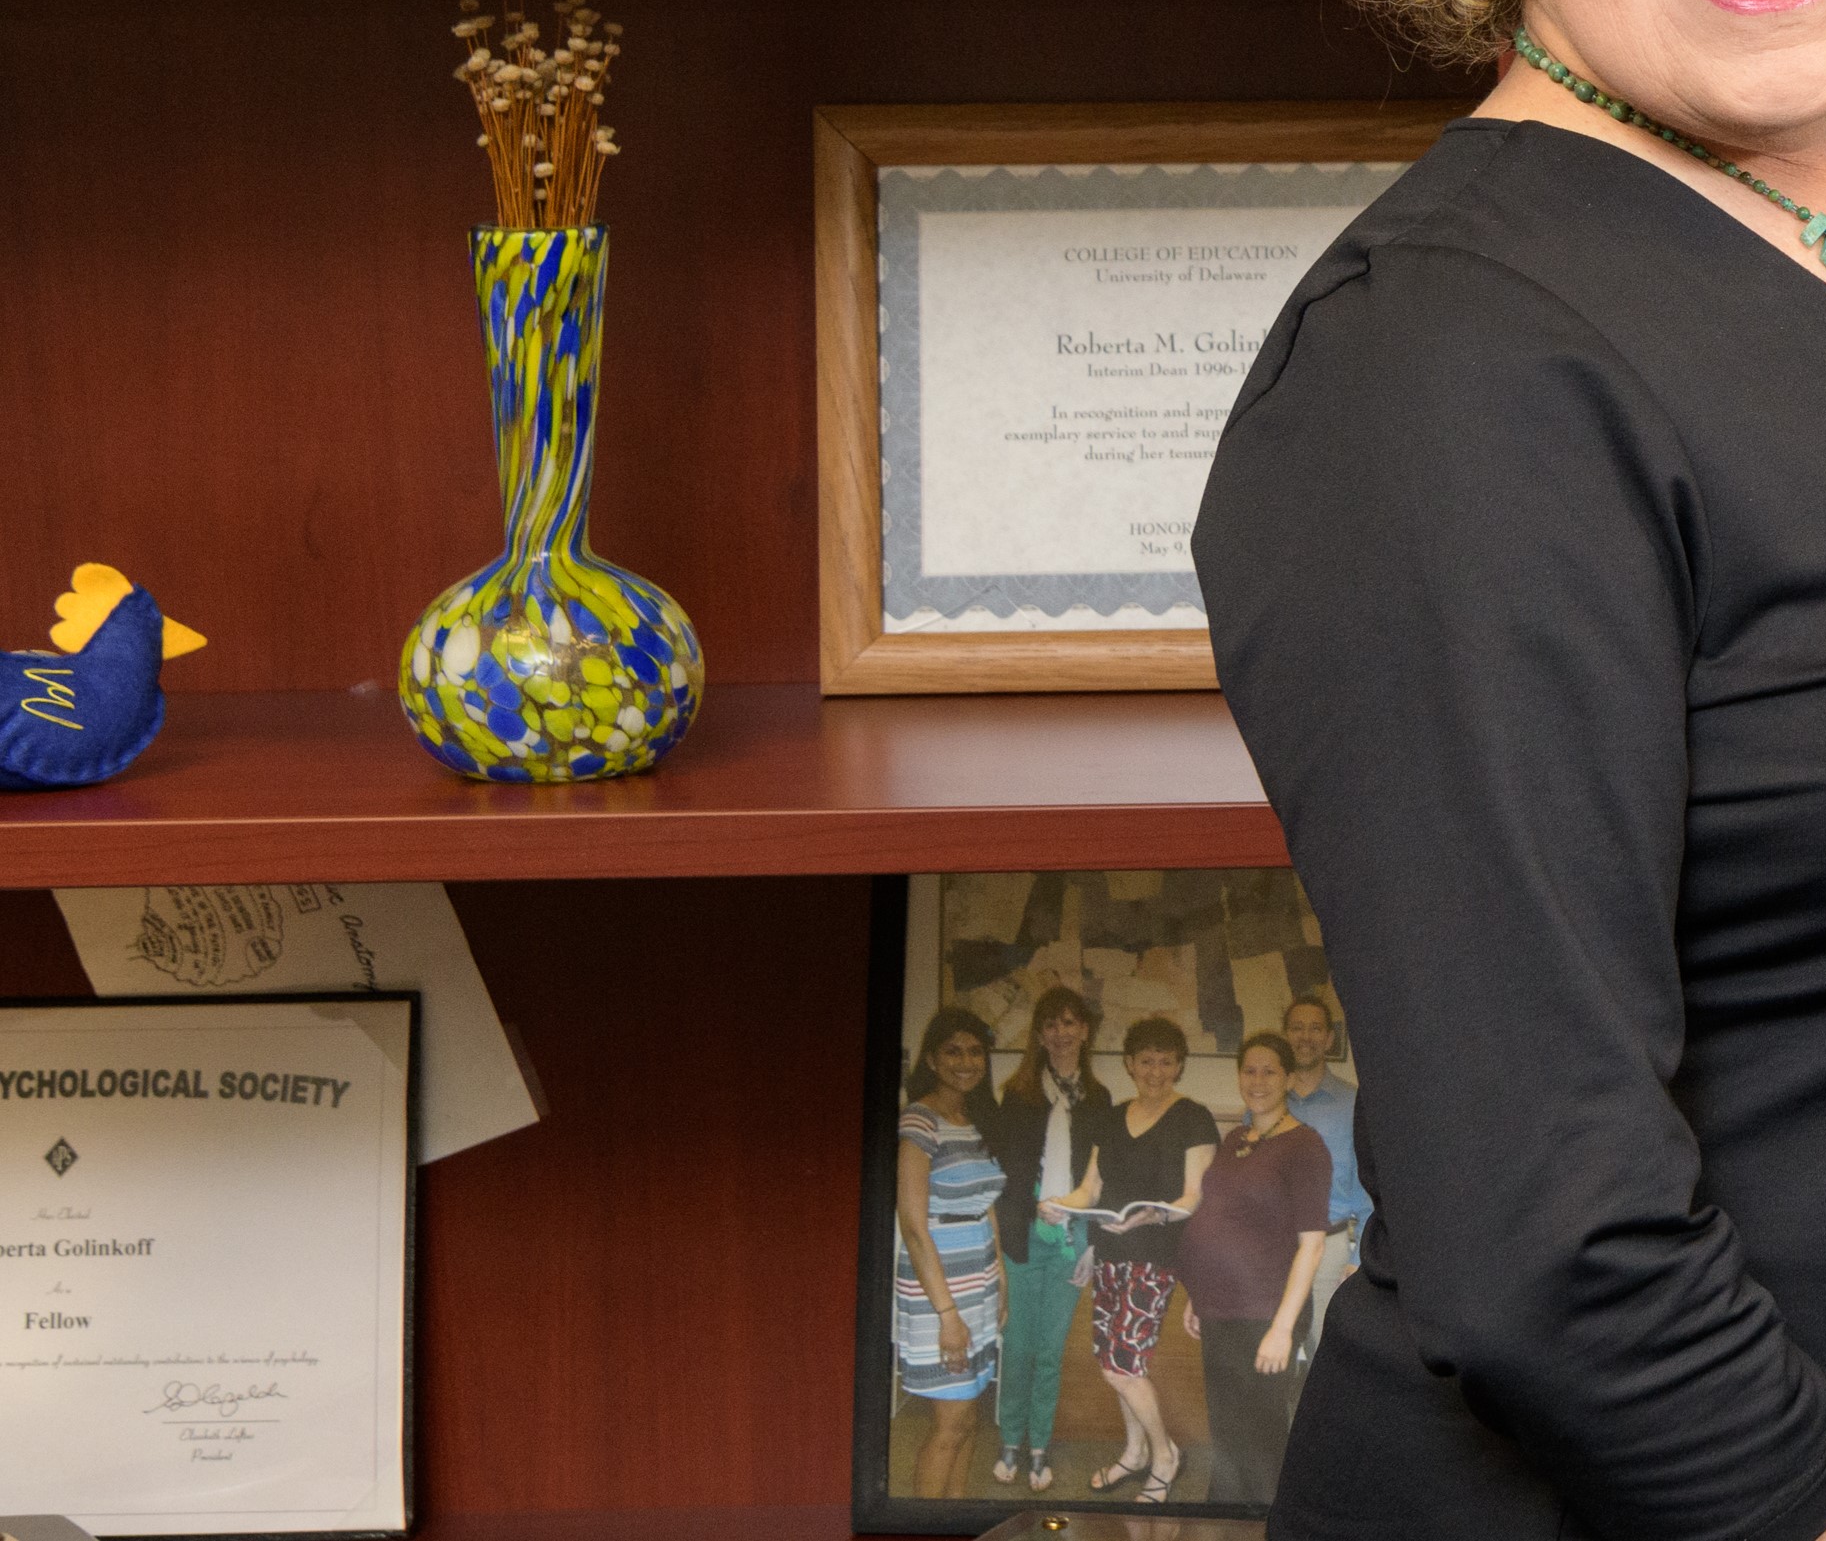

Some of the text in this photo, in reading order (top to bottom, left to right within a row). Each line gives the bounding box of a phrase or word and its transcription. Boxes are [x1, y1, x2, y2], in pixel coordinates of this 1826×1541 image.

[1064, 244, 1298, 263] COLLEGE OF EDUCATION
[1095, 265, 1268, 286] University of Delaware
[1056, 328, 1268, 356] Roberta M. Golin
[1087, 362, 1188, 378] Interim Dean
[218, 1070, 351, 1109] SOCIETY
[54, 1237, 156, 1258] Golinkoff
[24, 1311, 93, 1330] Fellow
